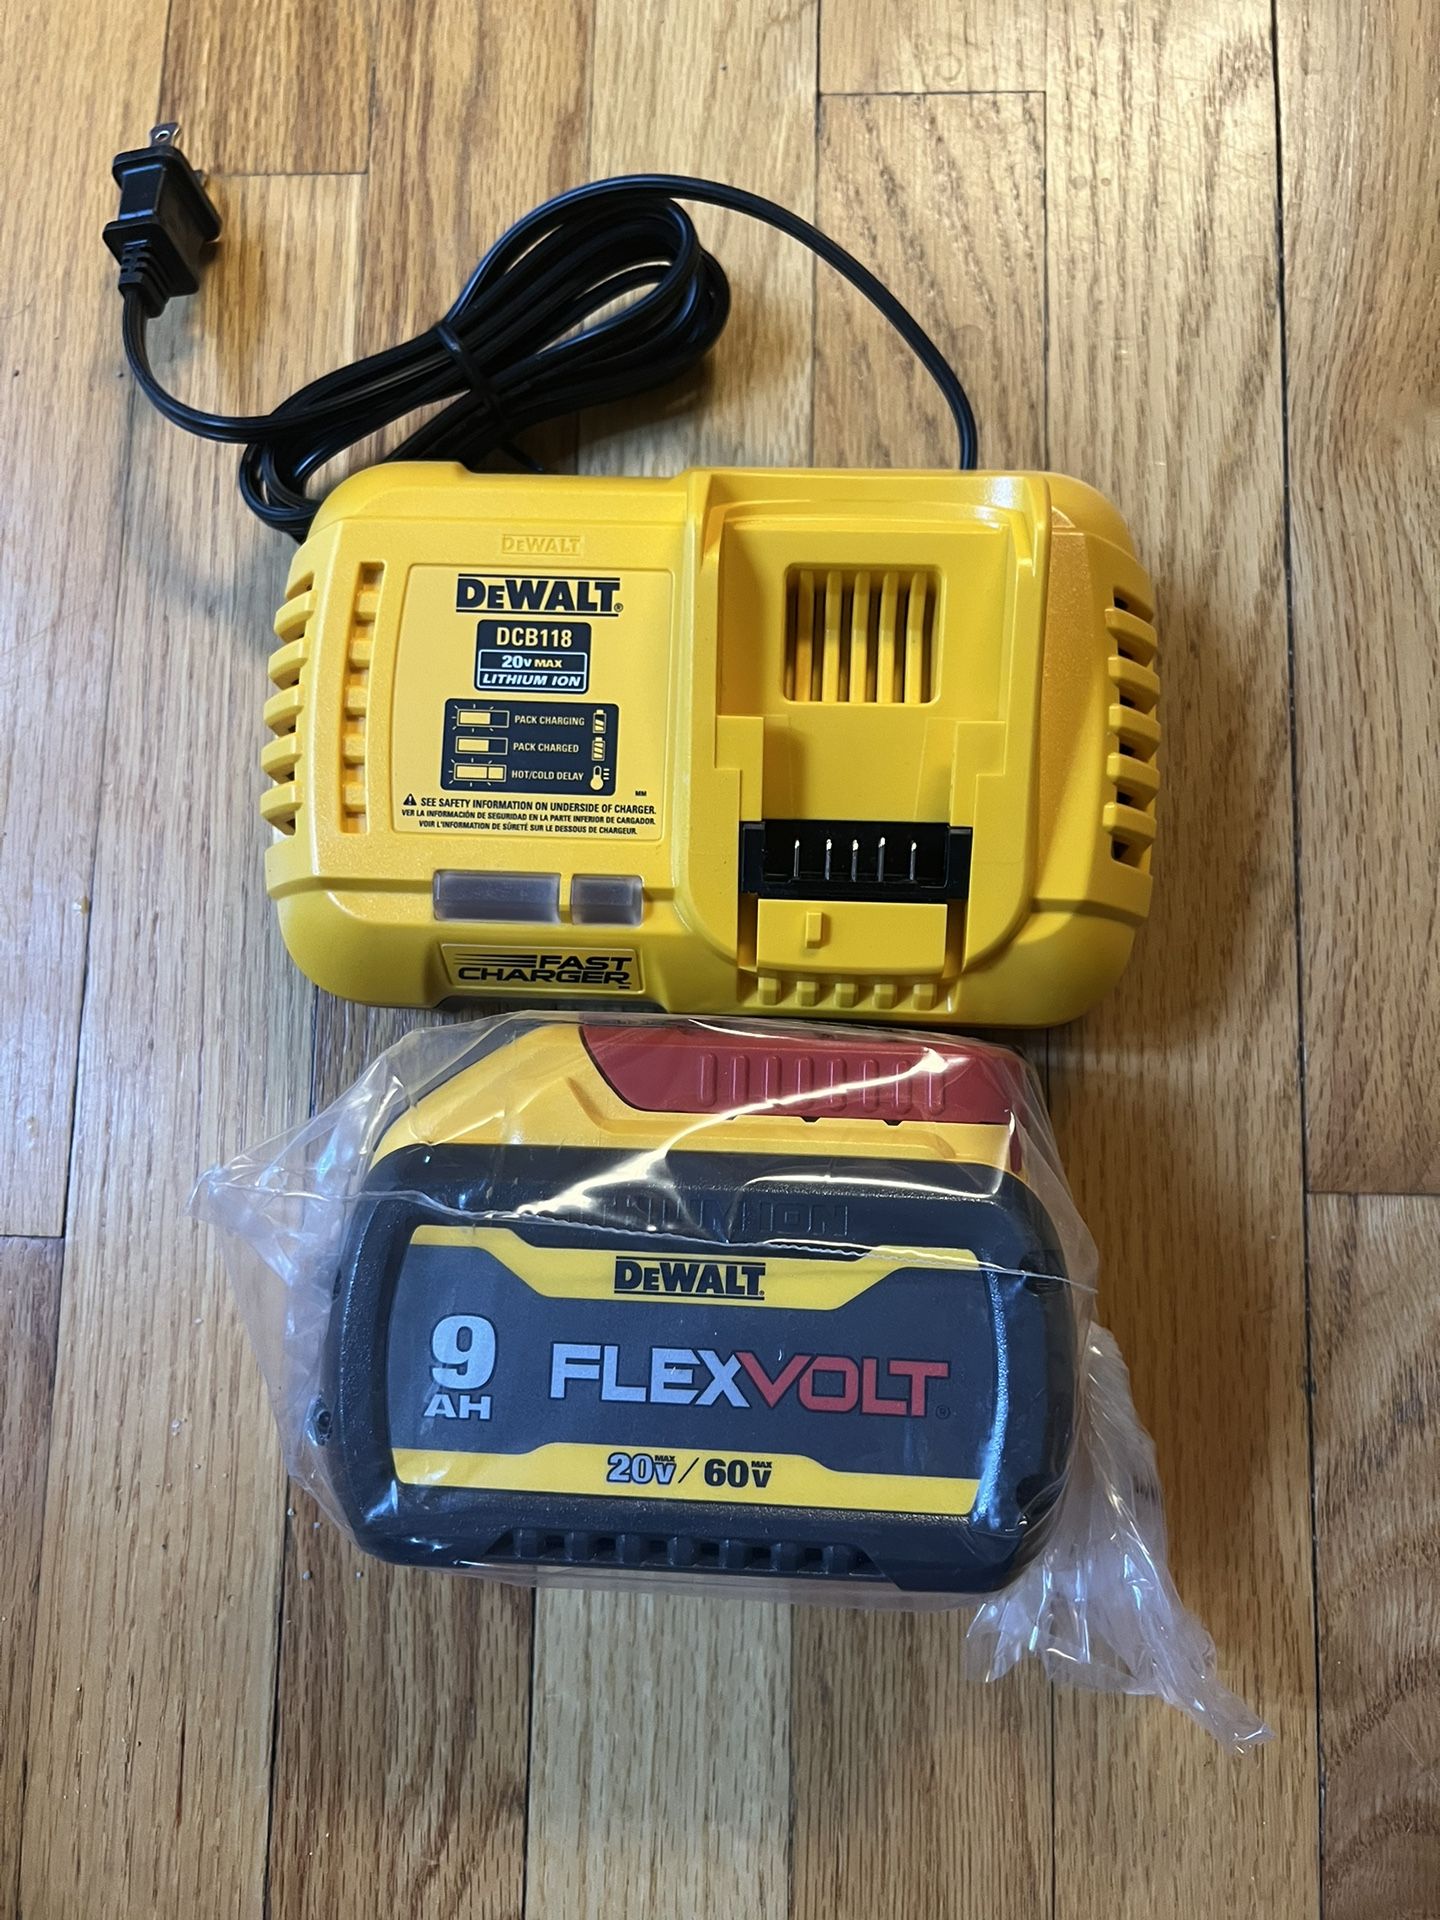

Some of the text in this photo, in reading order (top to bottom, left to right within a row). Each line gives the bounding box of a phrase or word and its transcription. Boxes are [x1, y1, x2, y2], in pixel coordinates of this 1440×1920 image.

[496, 627, 573, 647] DCB118
[534, 659, 562, 668] MAX
[482, 673, 581, 687] LITHIUM ION
[514, 715, 585, 726] PACK CHARGING
[513, 742, 579, 753] PACK CHARGED
[511, 770, 584, 781] HOT/COLD DELAY
[421, 797, 656, 814] SEE SAFETY INFORMATION ON UNDERSIDE OF CHARGER.
[426, 810, 476, 819] INFORMACIÓN
[487, 812, 527, 821] SEGURIDAD
[573, 815, 604, 823] INFERIOR
[616, 817, 656, 825] CARGADOR.
[419, 820, 435, 828] VOIR
[437, 820, 490, 829] L'INFORMATION
[492, 822, 501, 830] DE
[502, 821, 528, 831] SÛRETÉ
[545, 824, 553, 832] LE
[555, 825, 586, 833] DESSOUS
[599, 826, 638, 834] CHARGEUR.
[539, 955, 632, 971] FAST
[458, 967, 632, 985] CHARGER
[431, 1314, 497, 1391] 9
[550, 1342, 949, 1417] FLEXVOLT
[423, 1393, 492, 1420] AH
[654, 1455, 676, 1463] MAX
